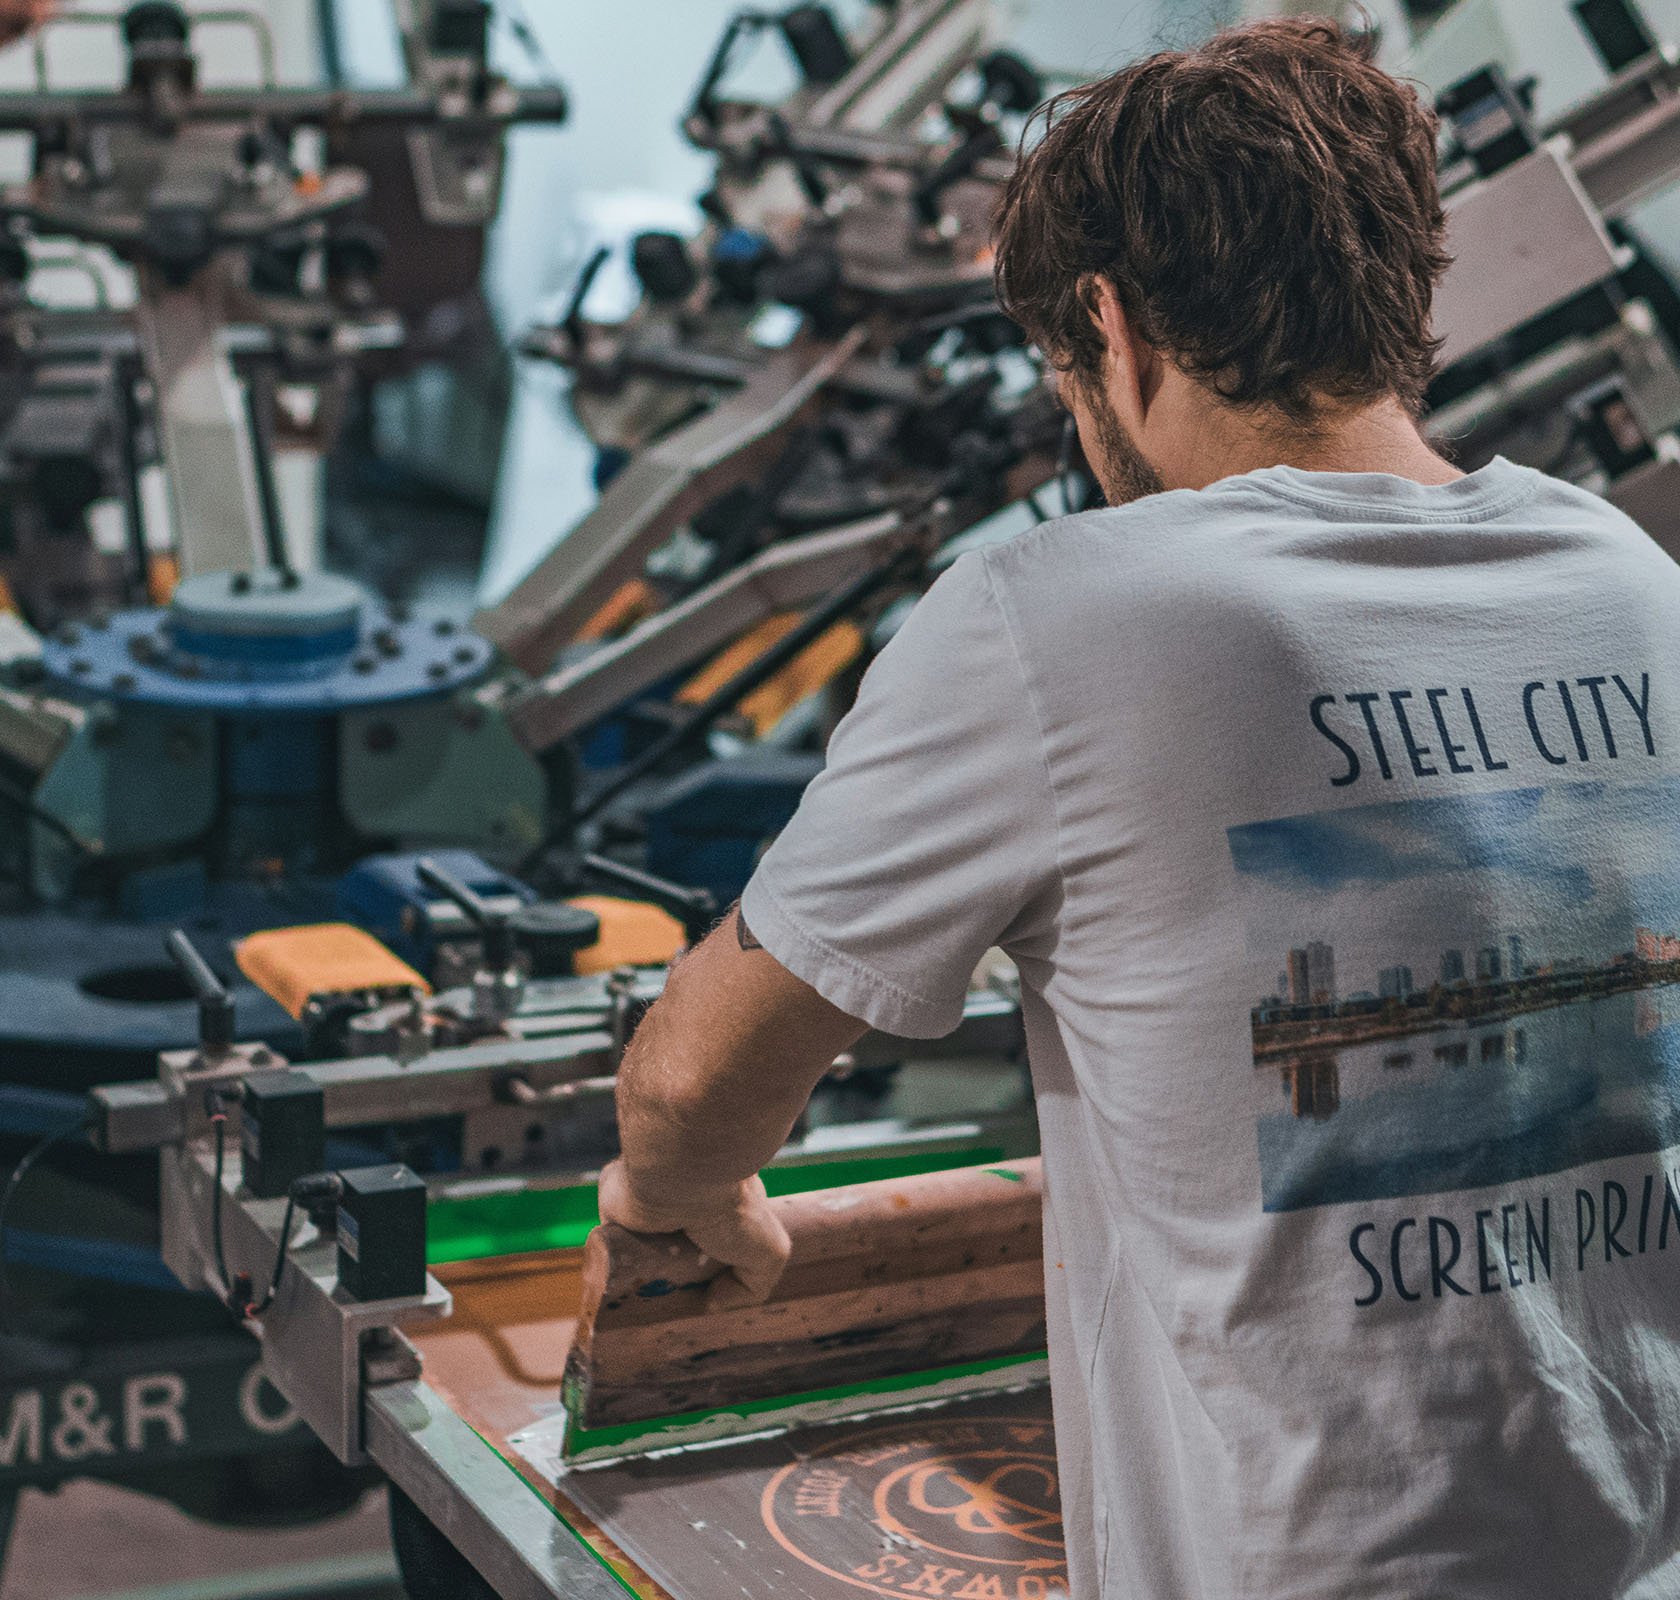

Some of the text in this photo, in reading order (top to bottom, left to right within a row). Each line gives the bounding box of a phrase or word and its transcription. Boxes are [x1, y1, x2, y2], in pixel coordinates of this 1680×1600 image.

[1309, 672, 1656, 787] STEEL CITY
[1350, 1197, 1551, 1307] SCREEN
[0, 1374, 188, 1465] M&R
